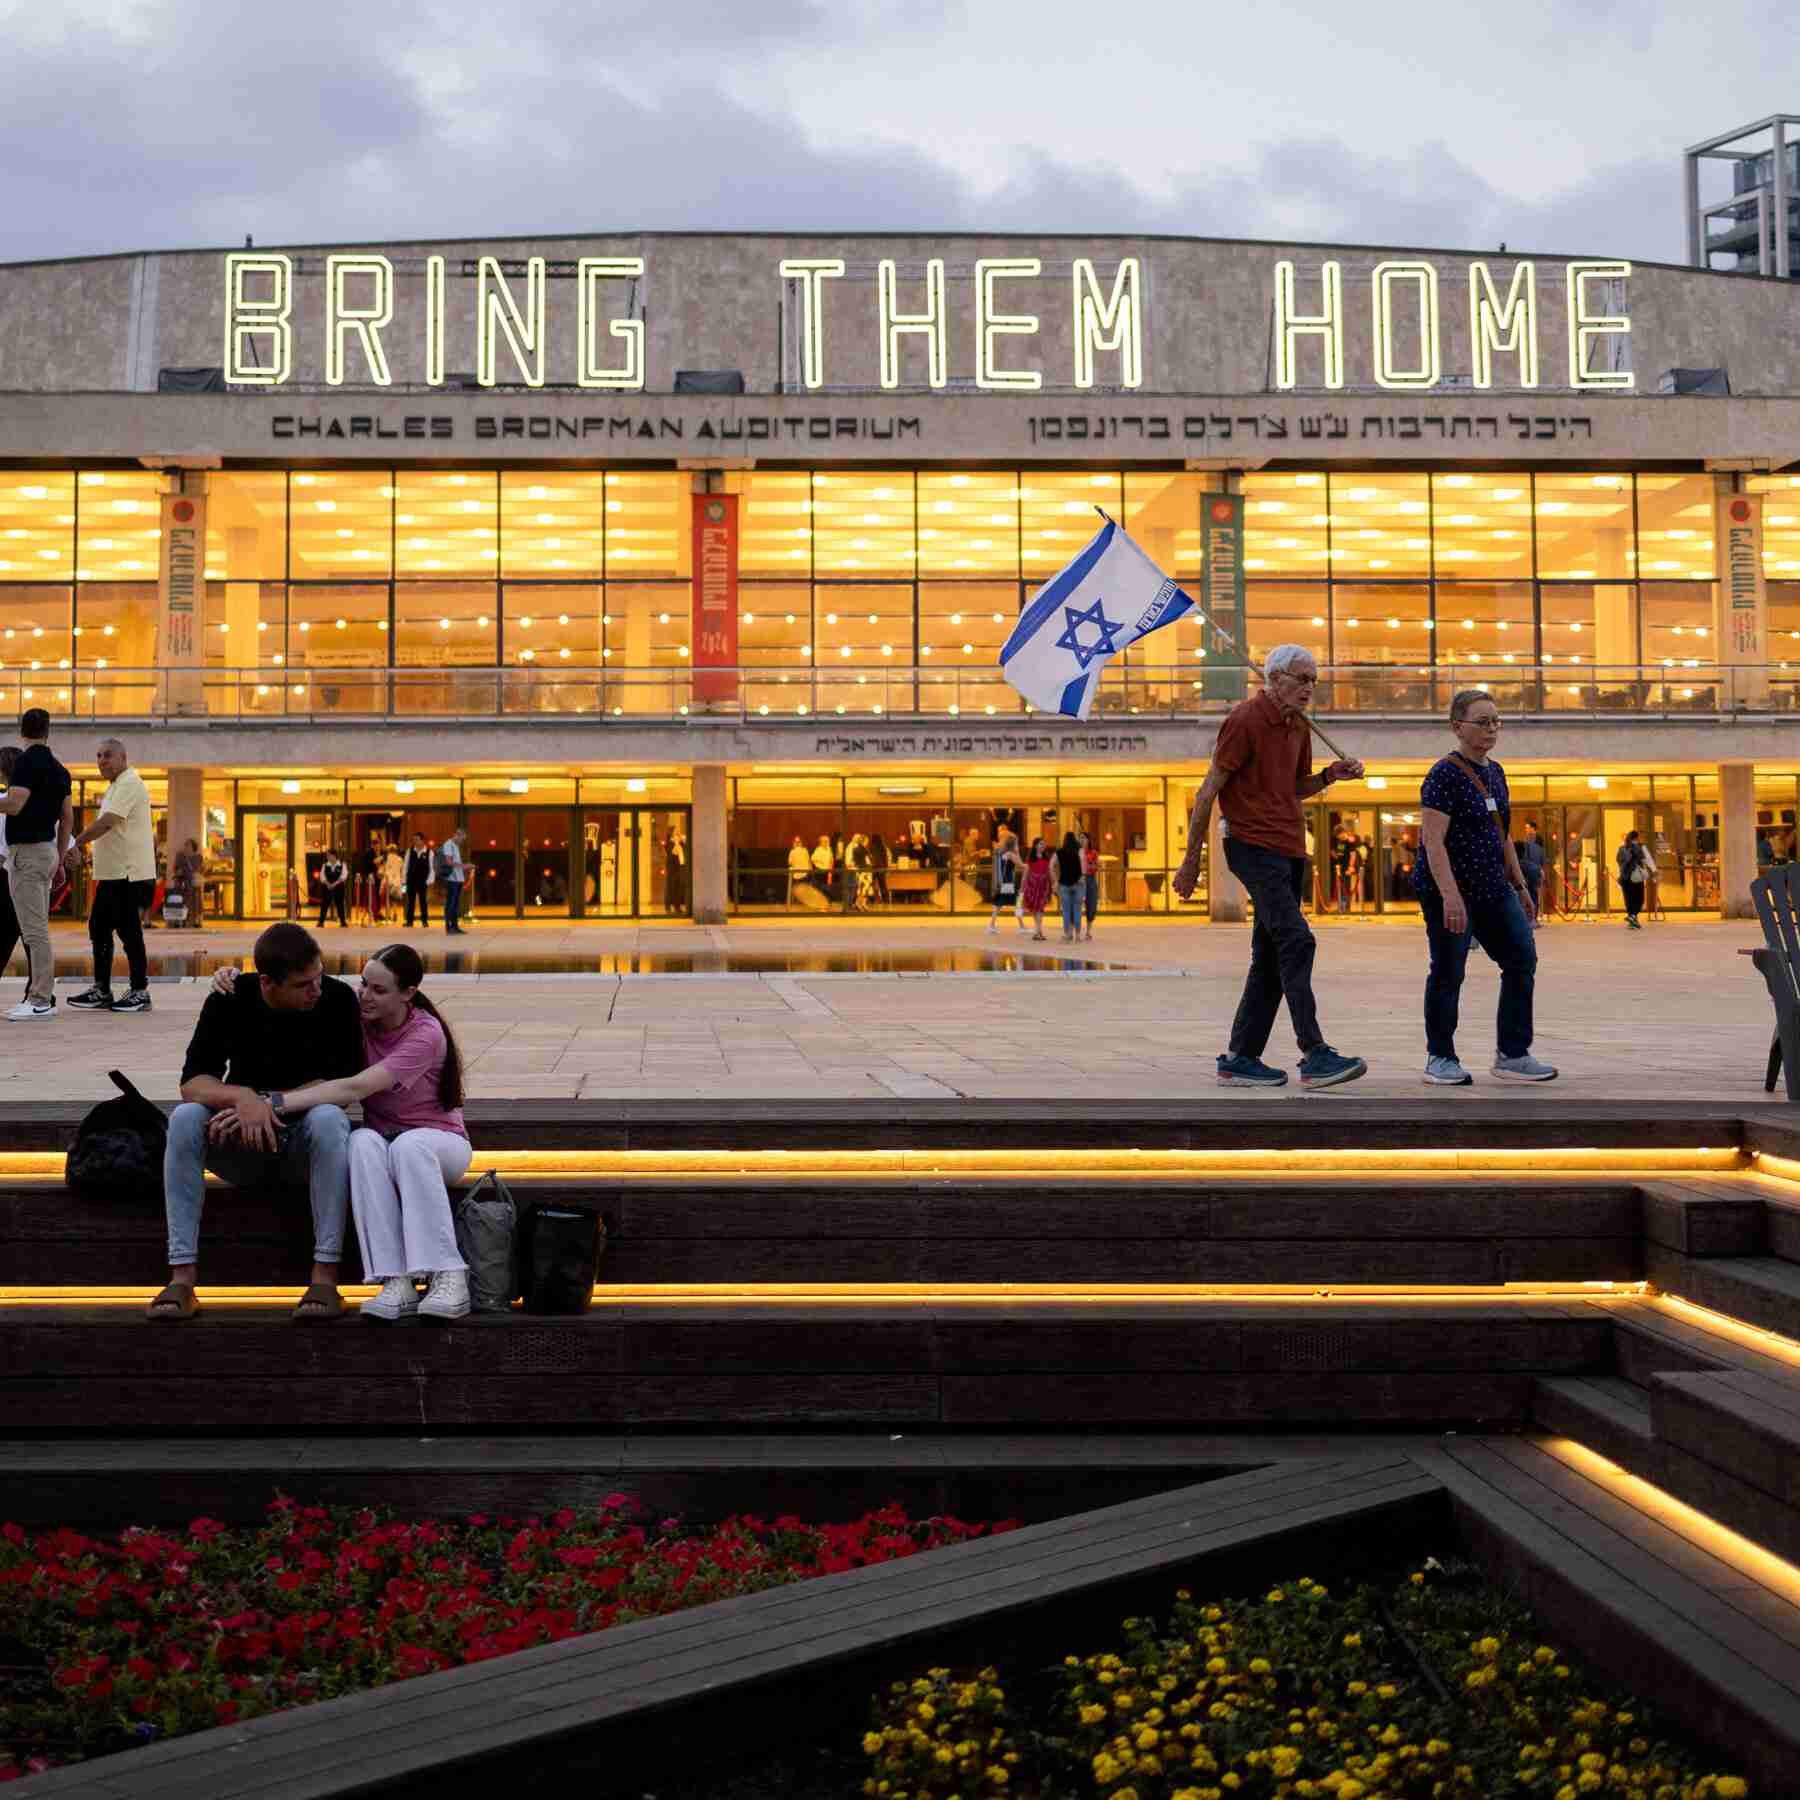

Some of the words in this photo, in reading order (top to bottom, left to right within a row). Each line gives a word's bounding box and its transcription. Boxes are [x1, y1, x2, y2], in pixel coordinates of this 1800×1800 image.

[223, 253, 646, 388] BRING
[779, 257, 1143, 391] THEM
[1274, 259, 1635, 391] HOME
[272, 416, 453, 439] CHARLES
[475, 417, 683, 439] BRONFMAN
[697, 417, 921, 440] AUDITORIUM
[1028, 416, 1172, 444] ברונפמן
[1361, 416, 1499, 440] התרבות
[1508, 413, 1592, 440] היכל
[815, 736, 916, 753] הישראלית
[923, 735, 1053, 752] הפילהרמונית
[1060, 735, 1147, 752] התזמורת
